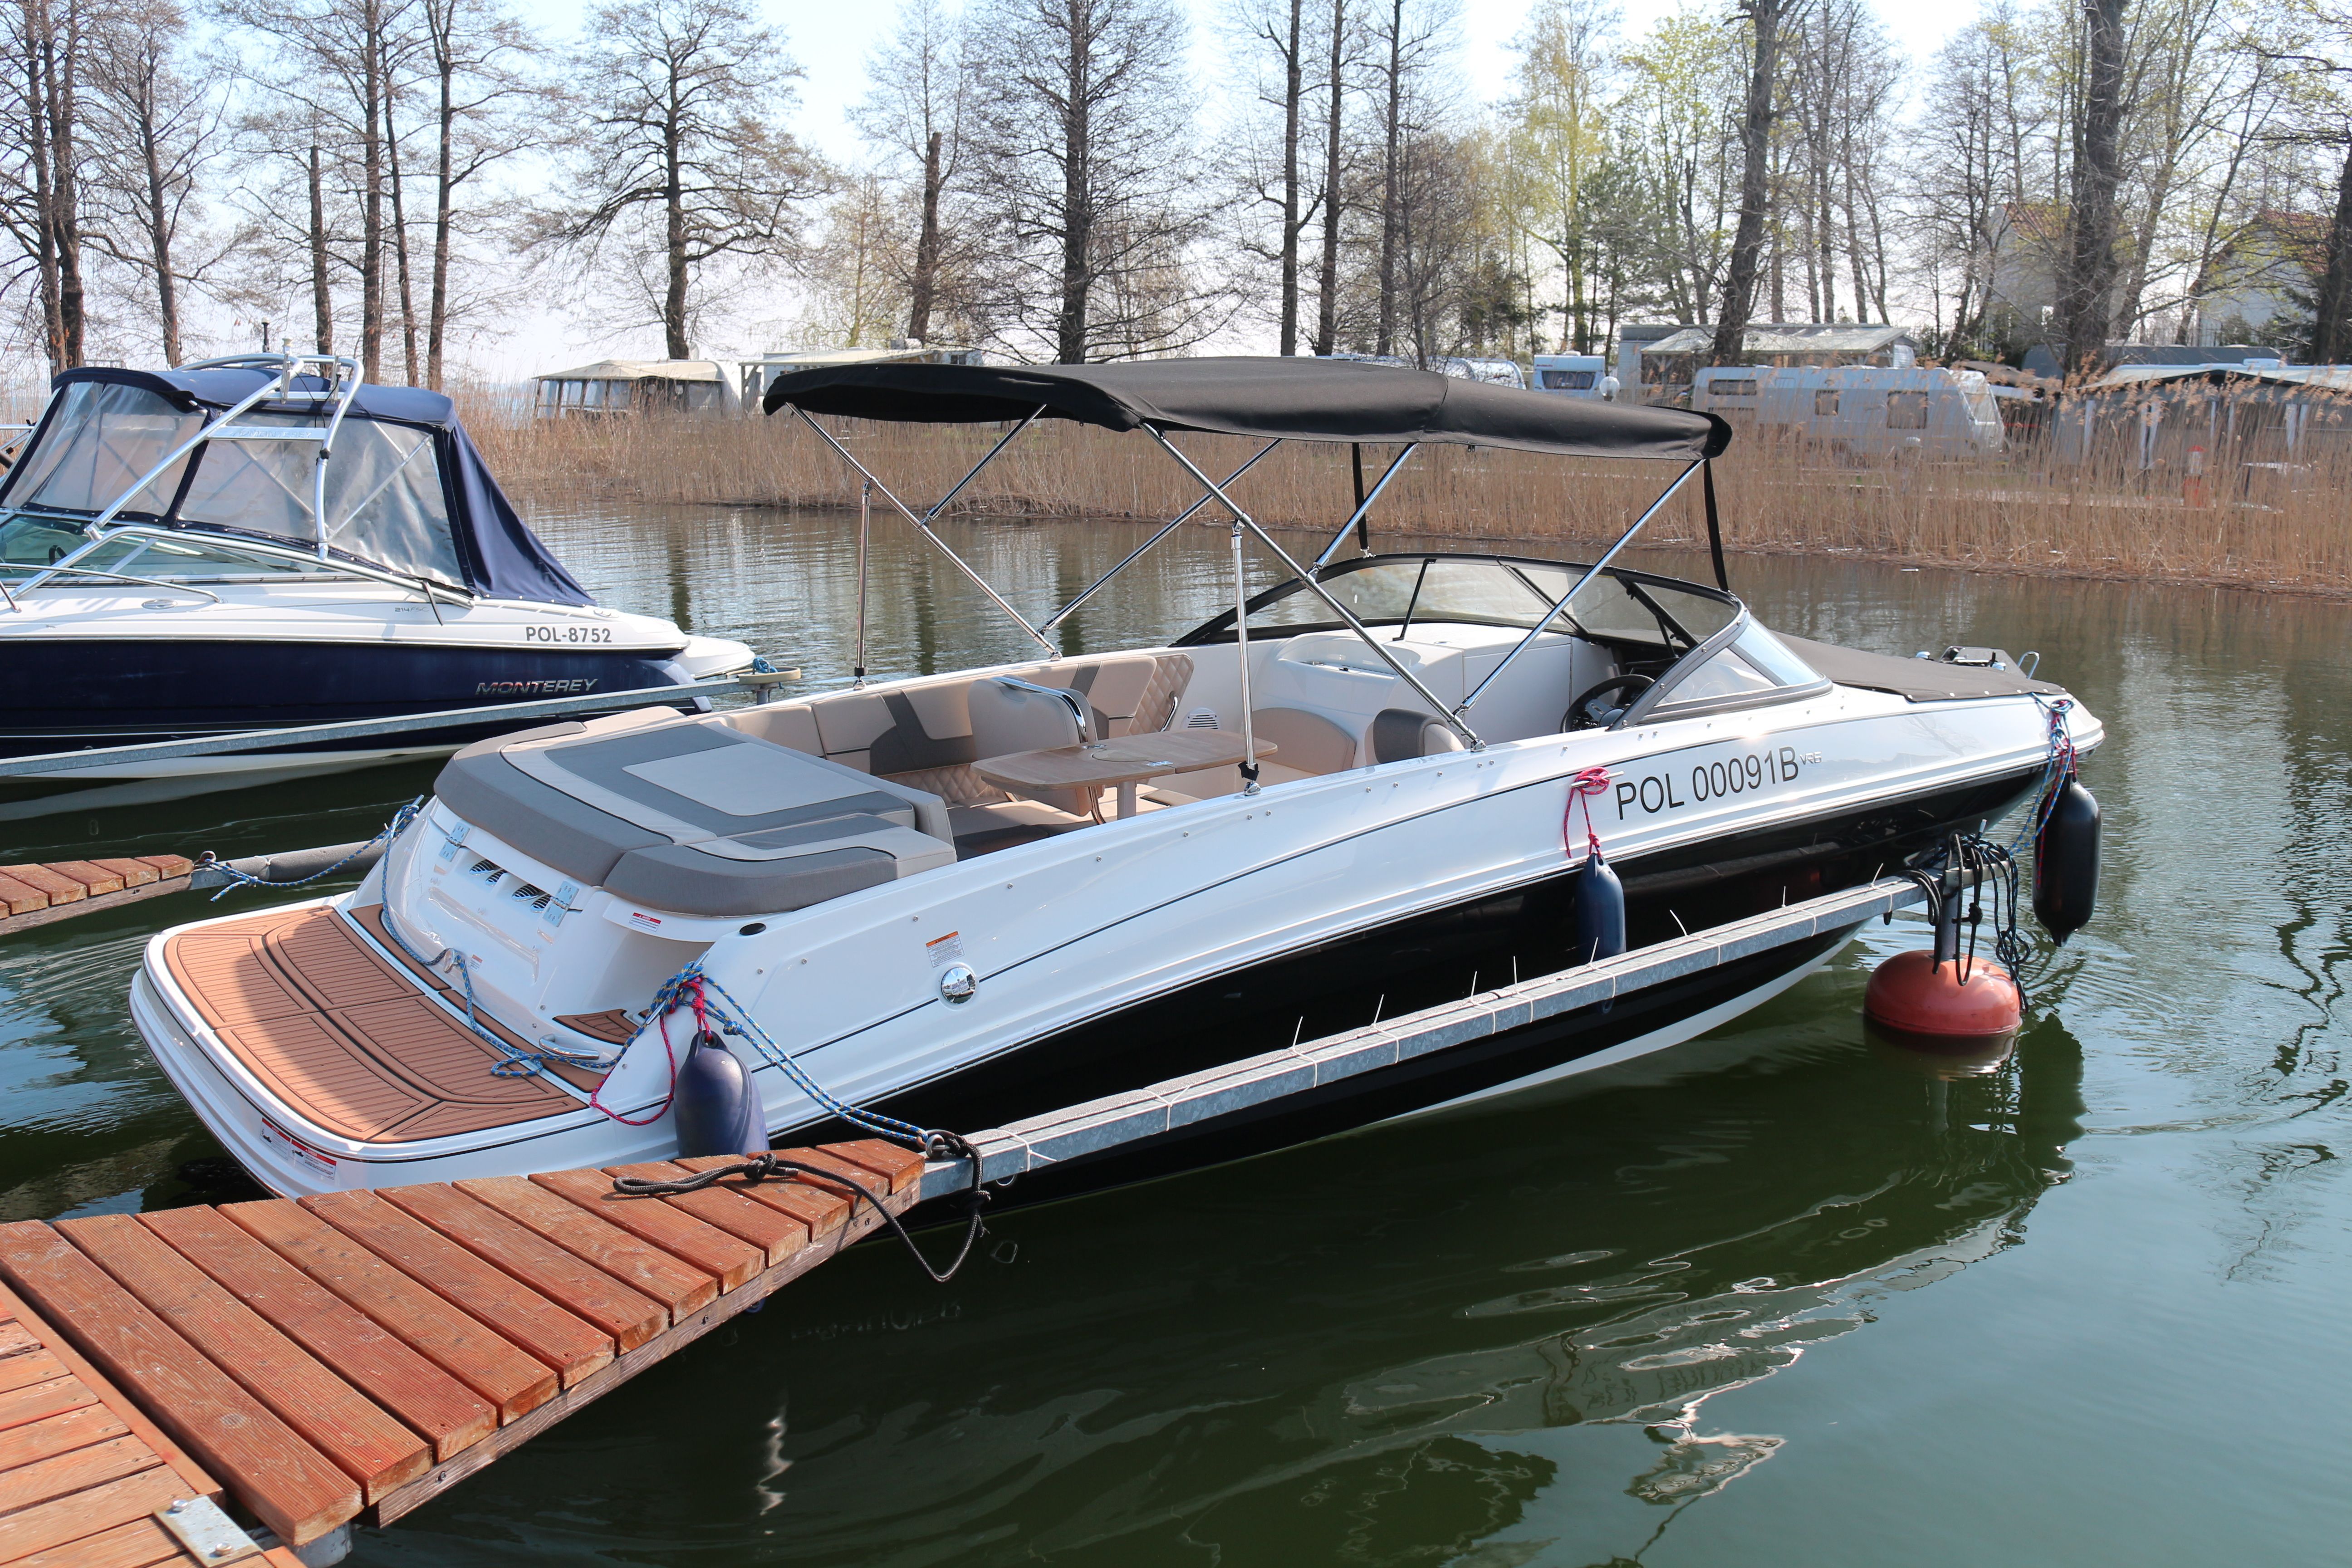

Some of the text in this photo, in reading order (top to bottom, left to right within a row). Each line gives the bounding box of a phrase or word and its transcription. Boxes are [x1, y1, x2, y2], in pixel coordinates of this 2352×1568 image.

[525, 626, 612, 643] POL-8752
[475, 678, 598, 695] MONTEREY
[1799, 751, 1822, 765] VR6
[1615, 746, 1799, 820] POL 00091B
